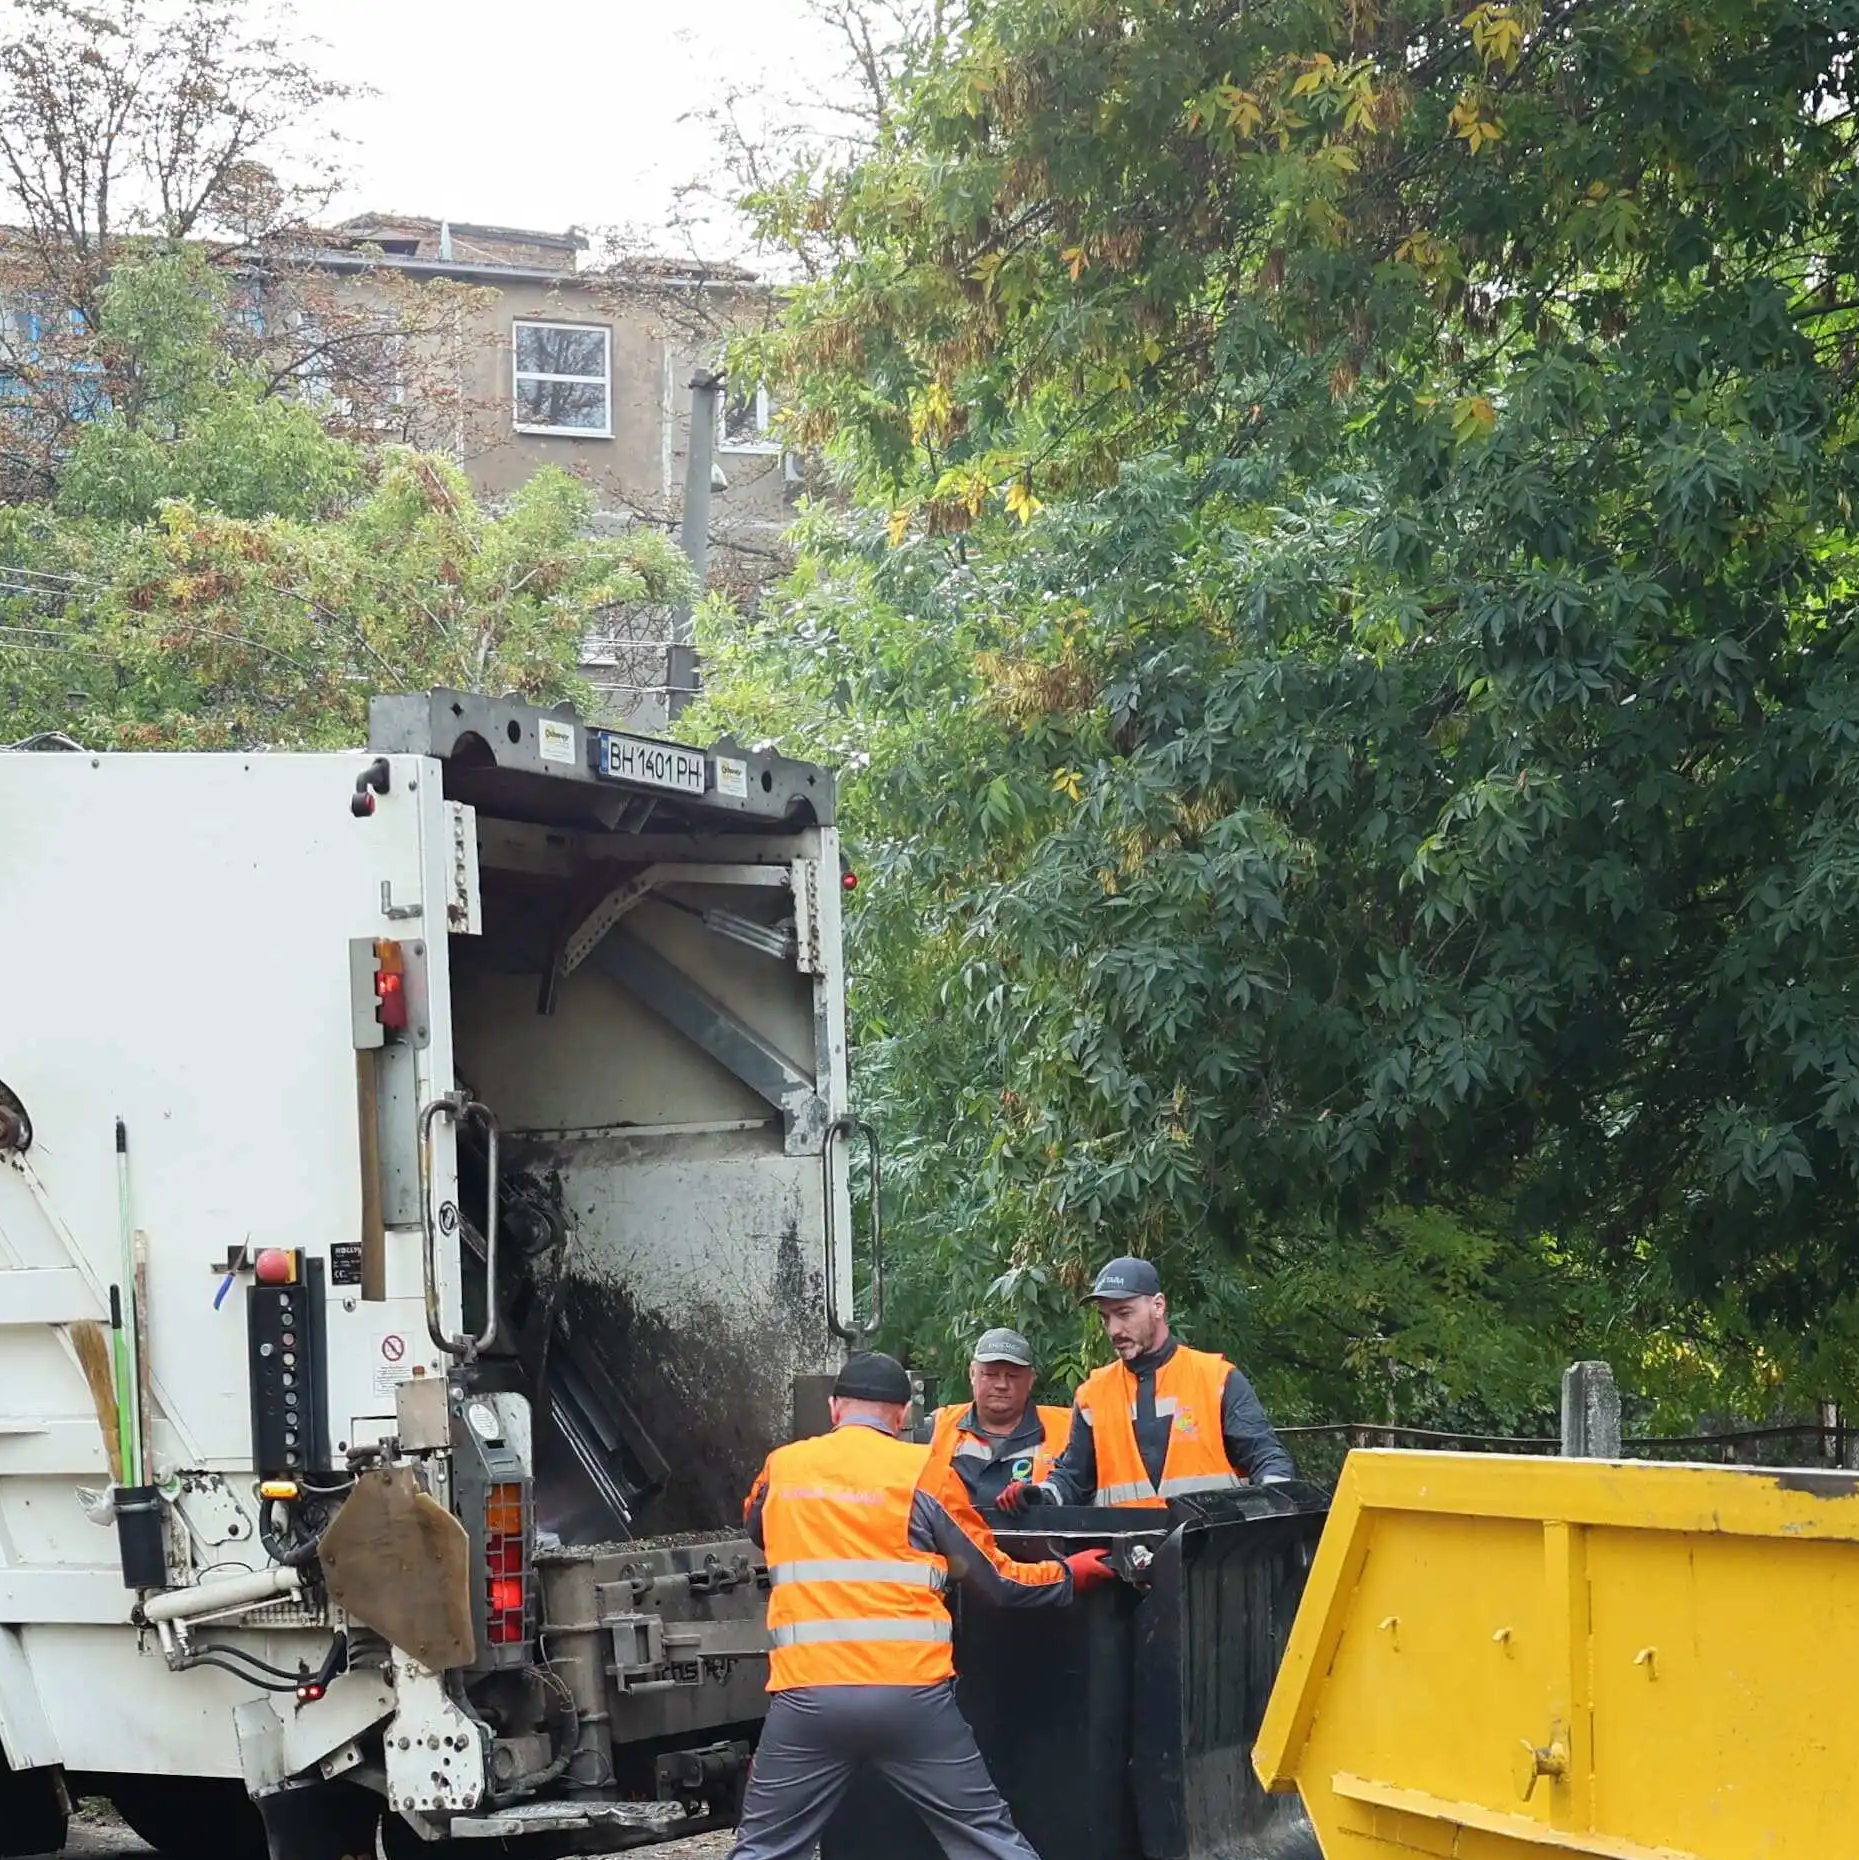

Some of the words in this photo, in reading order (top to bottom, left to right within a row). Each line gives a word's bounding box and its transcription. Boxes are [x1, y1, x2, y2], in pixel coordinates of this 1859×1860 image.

[610, 742, 634, 774] BH
[639, 749, 672, 783] 1401
[677, 756, 700, 788] PH
